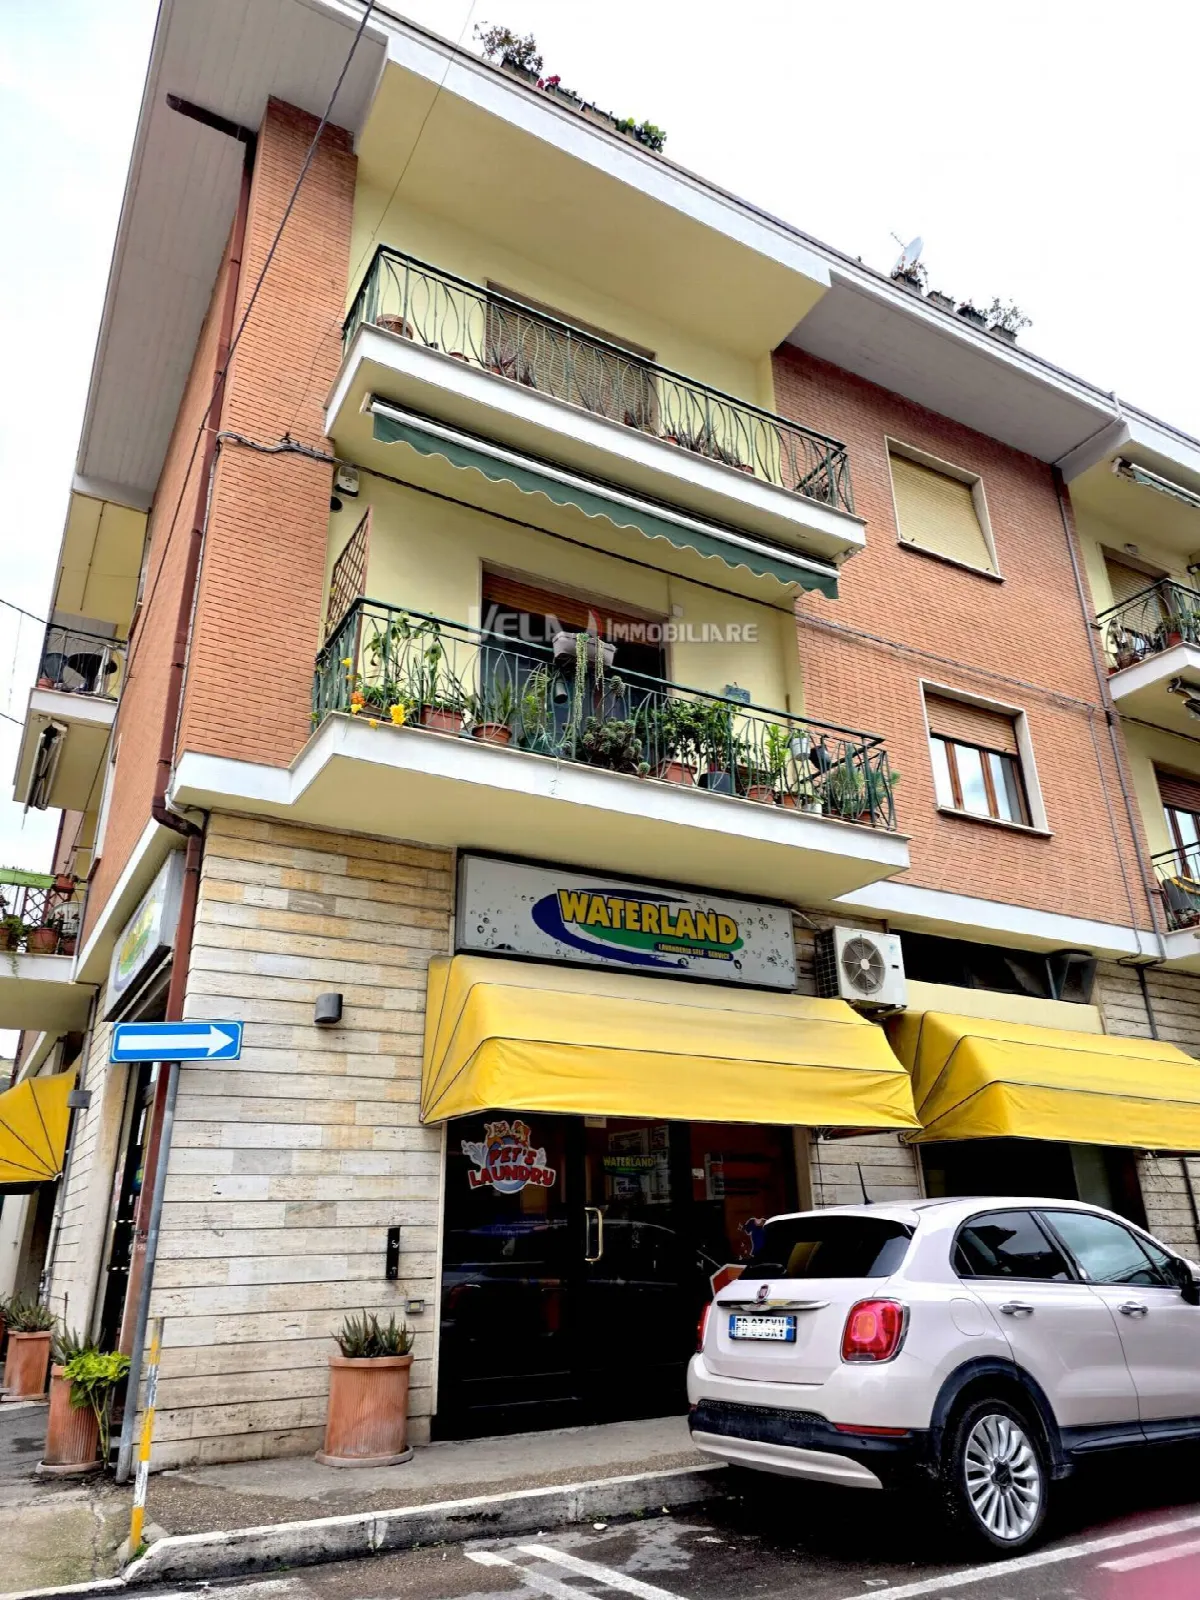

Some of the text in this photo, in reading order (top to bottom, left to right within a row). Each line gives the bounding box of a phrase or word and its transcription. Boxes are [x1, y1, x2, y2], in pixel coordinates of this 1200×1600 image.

[557, 889, 738, 944] WATERLAND
[489, 1147, 537, 1166] PET'S
[603, 1155, 654, 1168] WATERLAND
[469, 1165, 554, 1186] LAUNDRY
